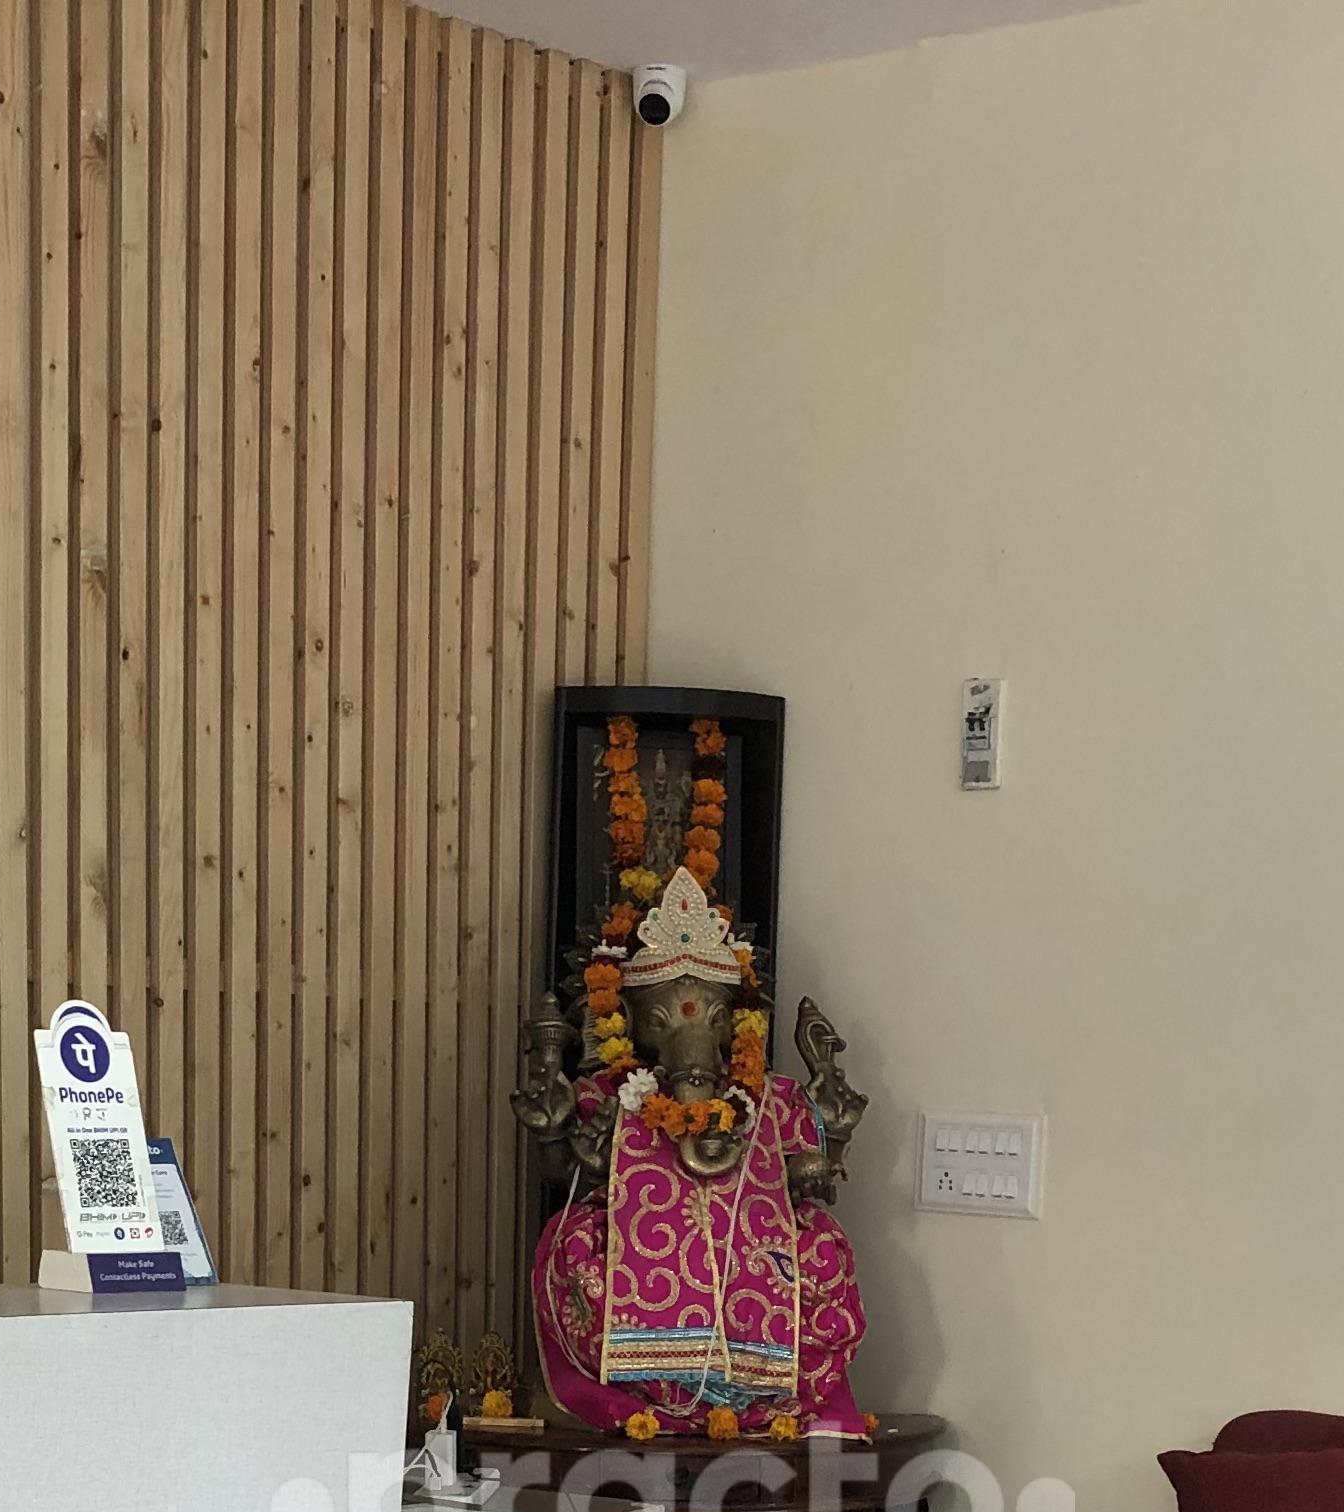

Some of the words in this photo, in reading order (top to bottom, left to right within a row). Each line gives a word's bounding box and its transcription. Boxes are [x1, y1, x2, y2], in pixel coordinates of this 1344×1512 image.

[58, 1086, 125, 1104] PhonePe
[118, 1260, 137, 1268] Make
[138, 1260, 154, 1268] Safe
[99, 1273, 141, 1282] Contactless
[141, 1271, 177, 1282] Payments
